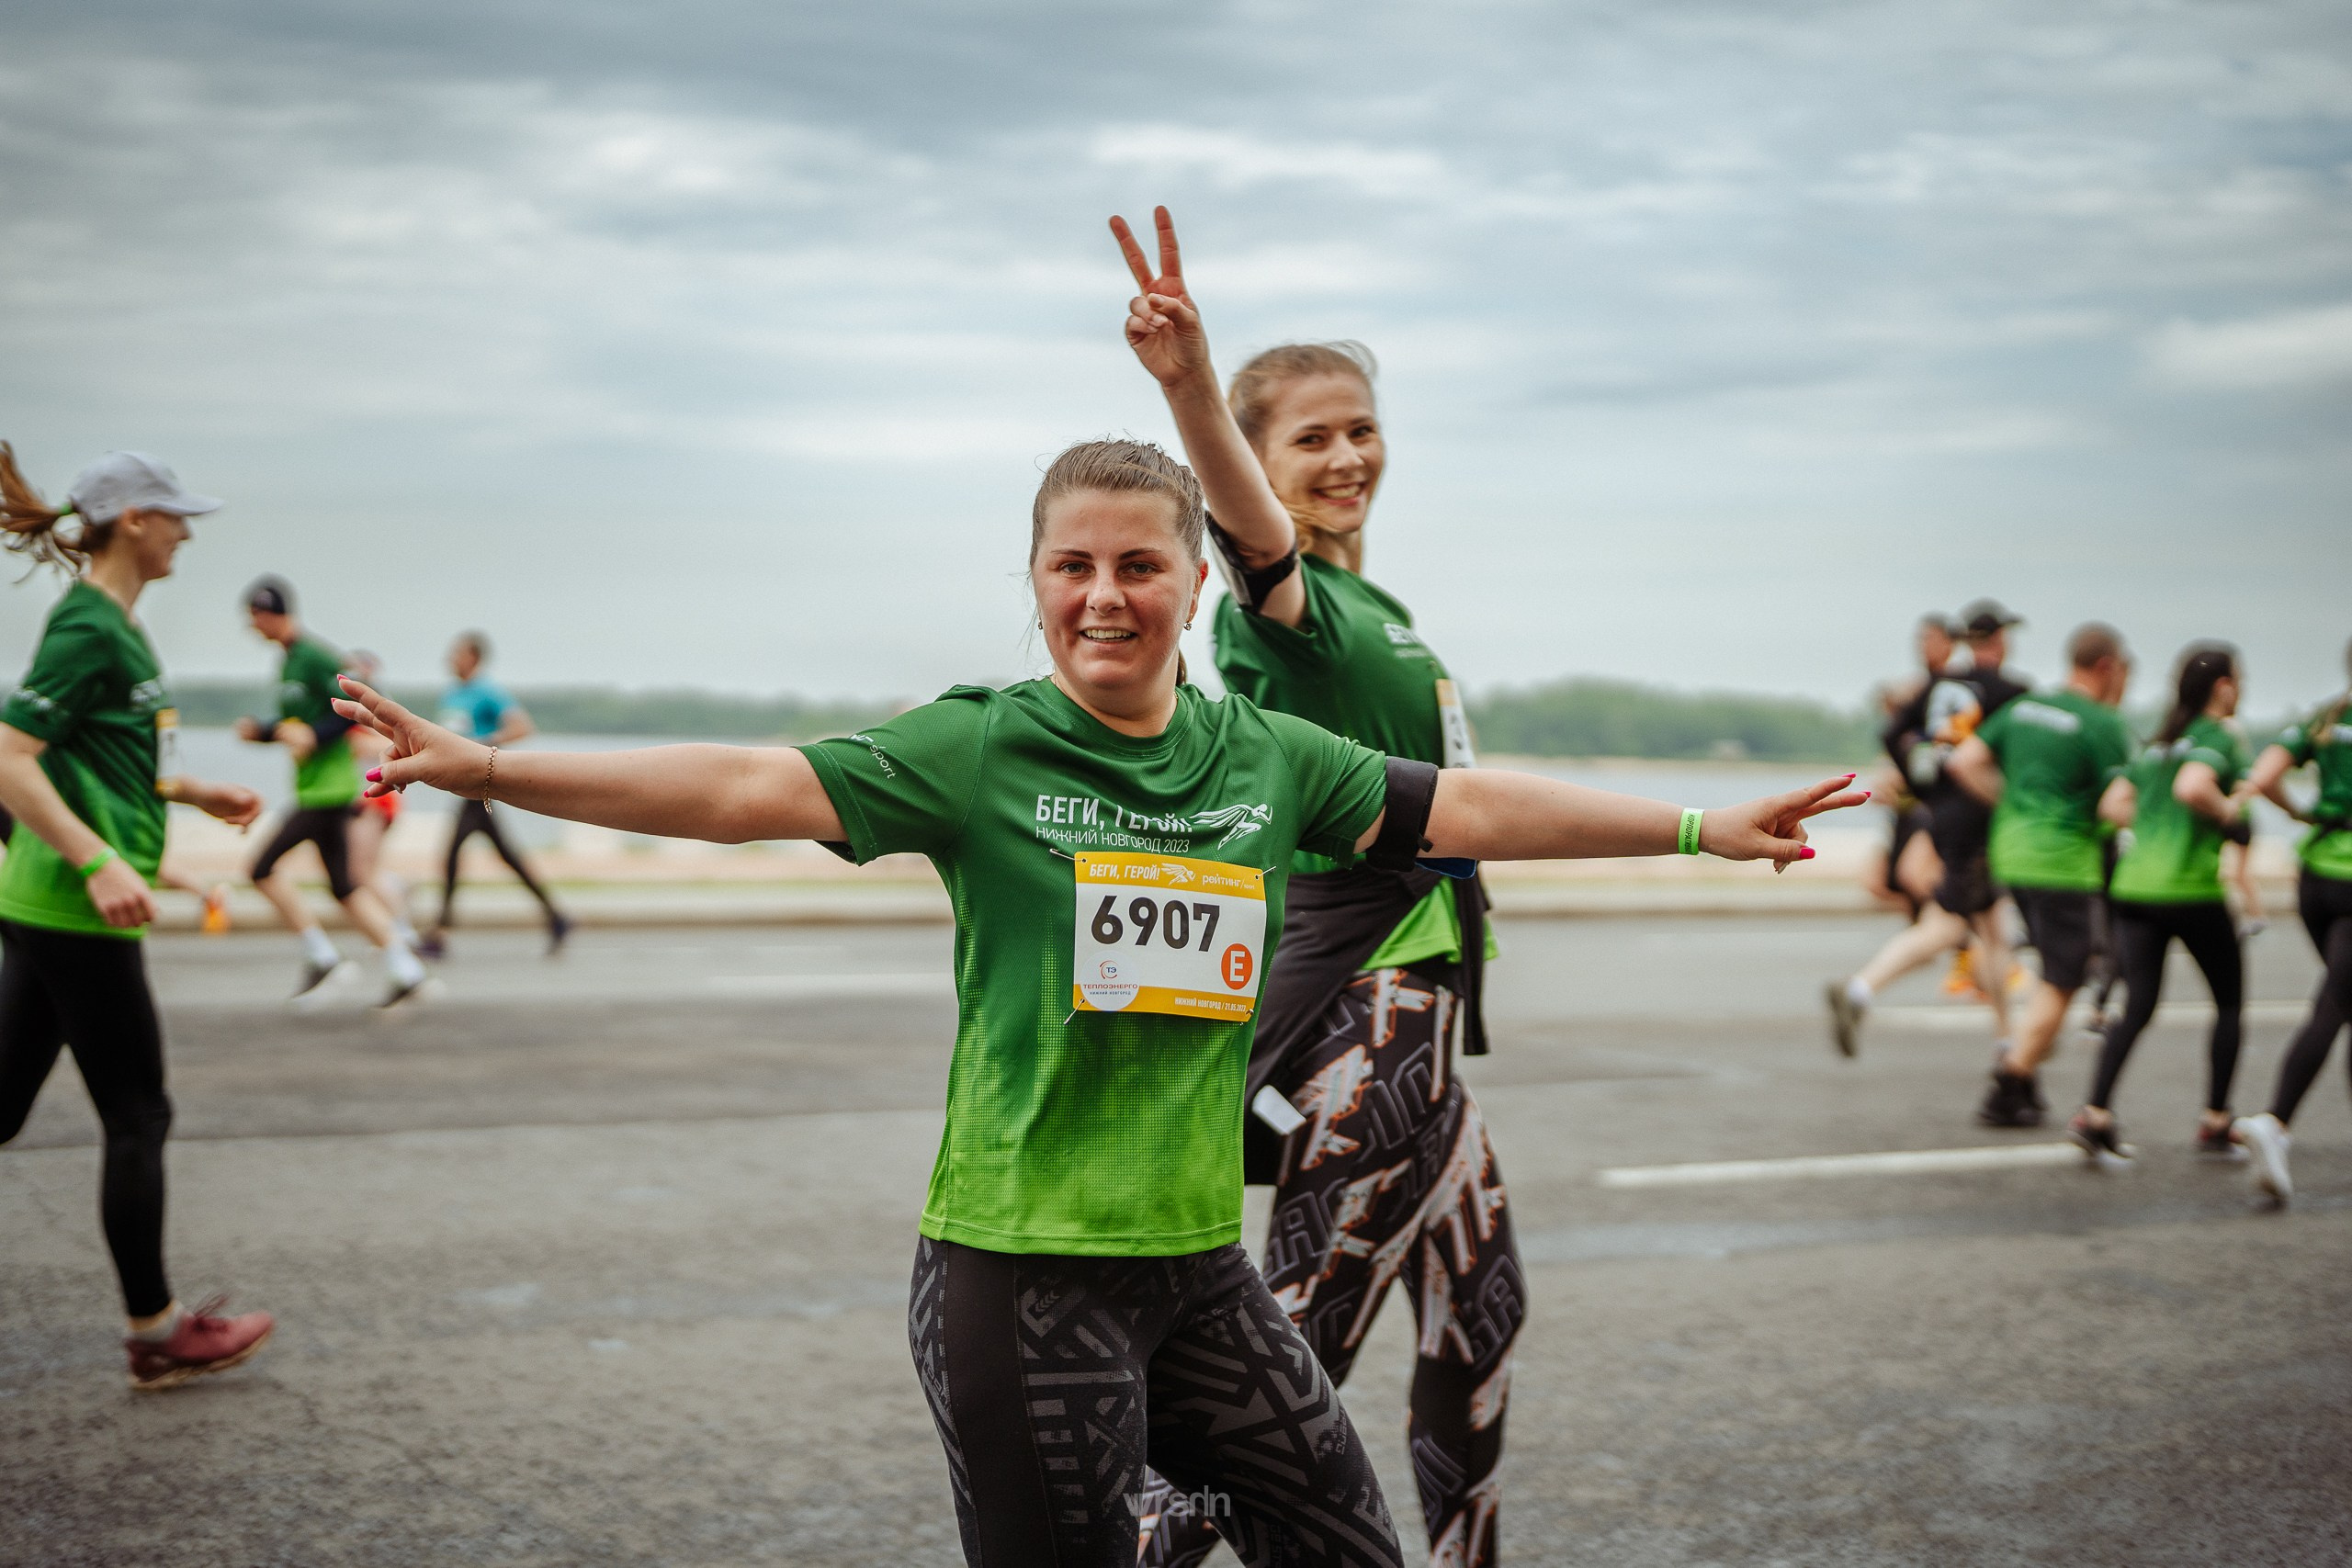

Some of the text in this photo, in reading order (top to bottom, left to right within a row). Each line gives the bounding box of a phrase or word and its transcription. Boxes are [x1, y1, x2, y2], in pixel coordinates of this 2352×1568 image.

[1036, 795, 1105, 832] БЕГИ,
[1035, 826, 1190, 853] НИЖНИЙ НОВГОРОД 2023
[1089, 863, 1160, 880] БЕГИ, ГЕРОЙ!
[1091, 895, 1220, 953] 6907
[1175, 997, 1197, 1007] НИЖНИЙ
[1197, 999, 1222, 1011] НОВГОРОД
